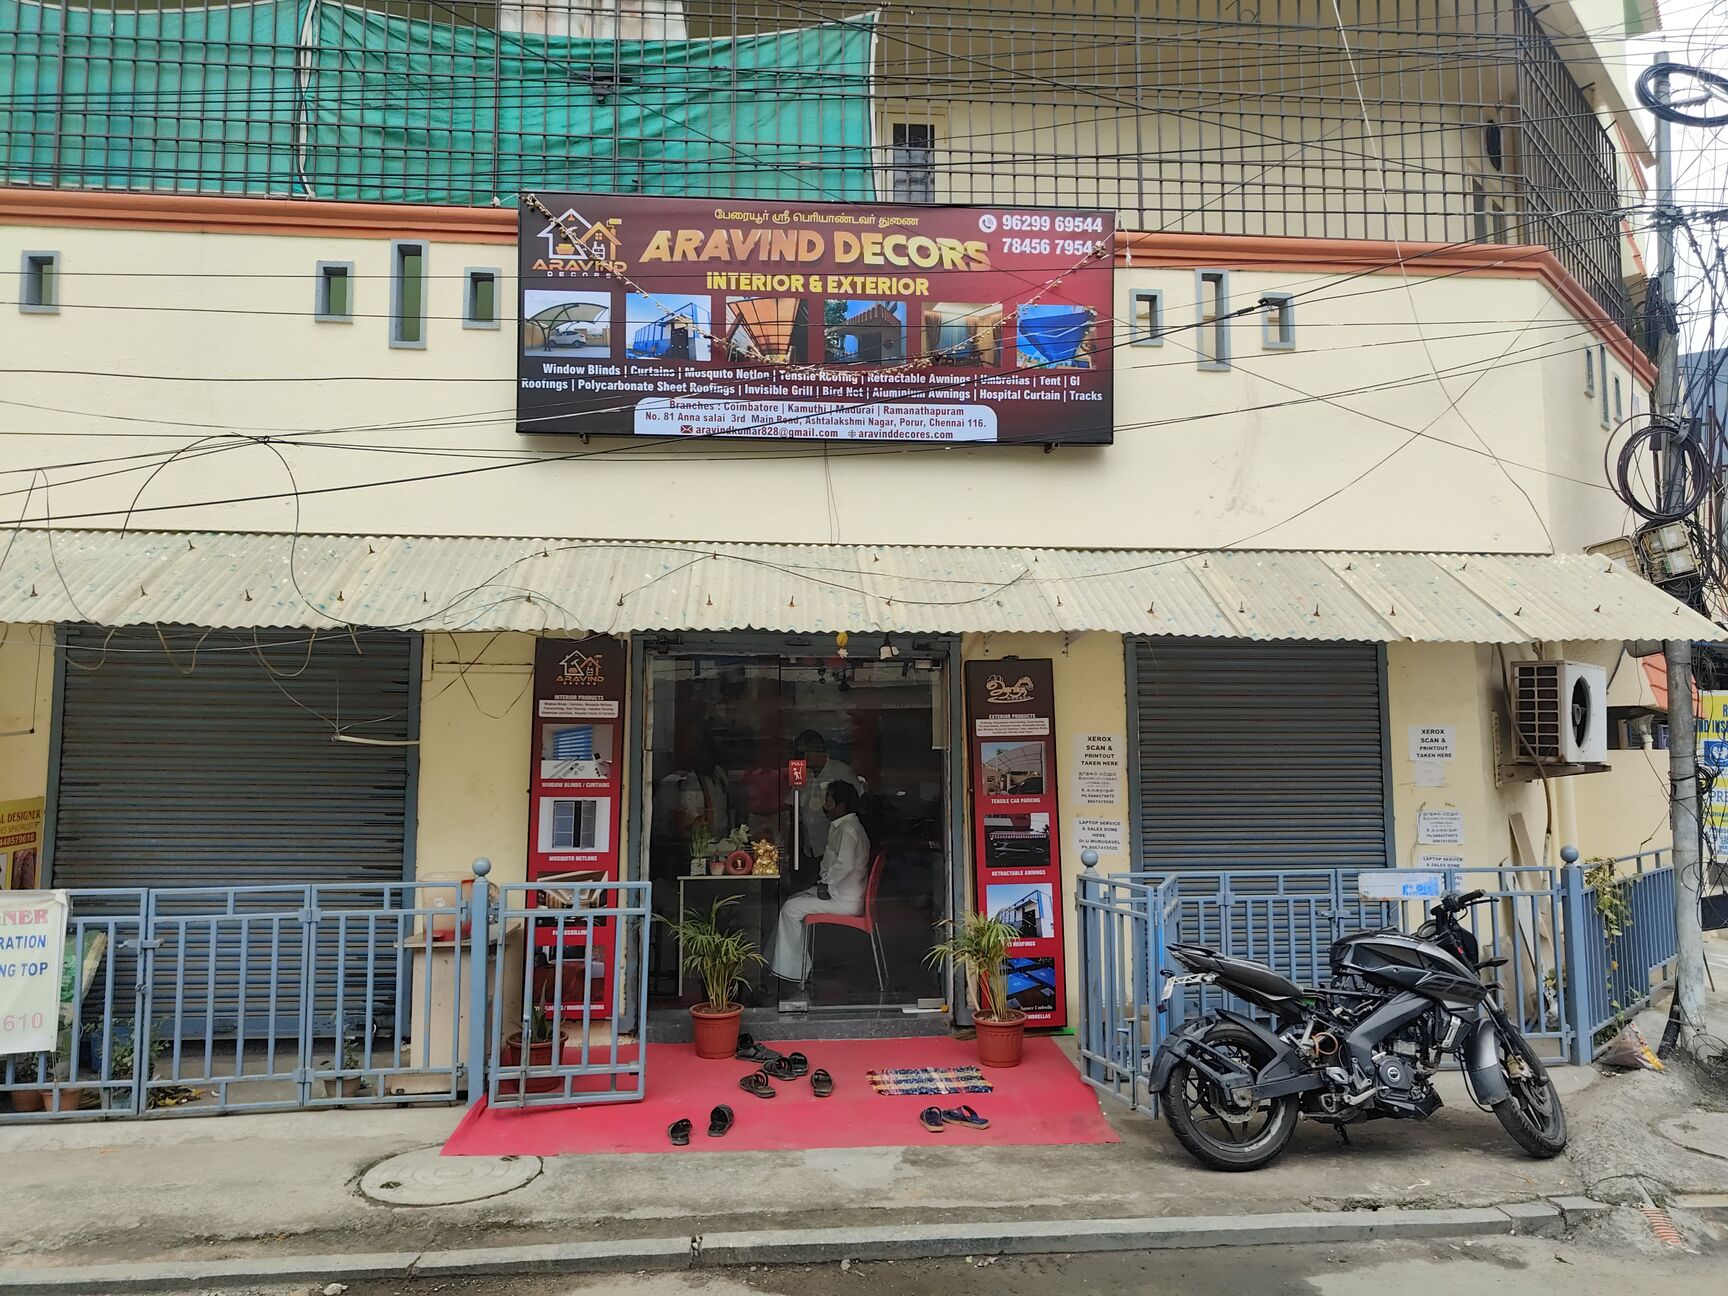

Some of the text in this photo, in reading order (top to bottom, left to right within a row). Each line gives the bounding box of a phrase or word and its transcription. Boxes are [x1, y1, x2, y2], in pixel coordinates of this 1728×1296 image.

[1002, 215, 1103, 233] 96299 69544
[639, 229, 992, 272] ARAVIND DECORS
[1002, 238, 1103, 256] 78456 7954
[531, 258, 628, 273] ARAVIND
[706, 272, 929, 296] INTERIOR & EXTERIOR
[542, 363, 585, 375] Window
[587, 364, 621, 376] Blinds
[630, 365, 675, 378] Curtains
[684, 366, 734, 380] Mosquito
[867, 372, 926, 384] Retractable
[928, 373, 971, 386] Awnings
[980, 374, 1030, 385] Umbrellas
[1039, 376, 1061, 386] Tent
[1070, 376, 1080, 386] GI
[521, 378, 568, 391] Roofings
[578, 379, 654, 393] Polycarbonate
[656, 381, 687, 393] Sheet
[690, 382, 736, 396] Roofings
[744, 384, 788, 396] Invisible
[791, 385, 813, 396] Grill
[822, 386, 843, 396] Bird
[846, 386, 863, 397] Net
[872, 387, 926, 398] Aluminium
[928, 389, 971, 401] Awnings
[980, 389, 1021, 402] Hospital
[1023, 390, 1060, 401] Curtain
[1069, 390, 1103, 401] Tracks
[669, 400, 714, 411] Branches
[723, 401, 779, 412] Coimbatore
[787, 403, 827, 413] Kamuthi
[835, 405, 874, 414] Madurai
[883, 406, 964, 417] Ramanathapuram
[645, 411, 660, 421] No.
[663, 412, 674, 421] 81
[677, 413, 700, 421] Anna
[703, 413, 726, 422] salai
[731, 414, 746, 423] 3rd
[751, 415, 774, 424] Main
[805, 416, 866, 426] Ashtalakshmi
[868, 418, 897, 428] Nagar,
[899, 418, 926, 428] Porur,
[928, 418, 965, 428] Chennai
[967, 419, 987, 428] 116.
[695, 425, 954, 439] aravindkumar828@gmail.com aravinddecores.com
[8, 809, 41, 823] DESIGNER
[0, 908, 49, 926] NER
[21, 961, 49, 977] TOP
